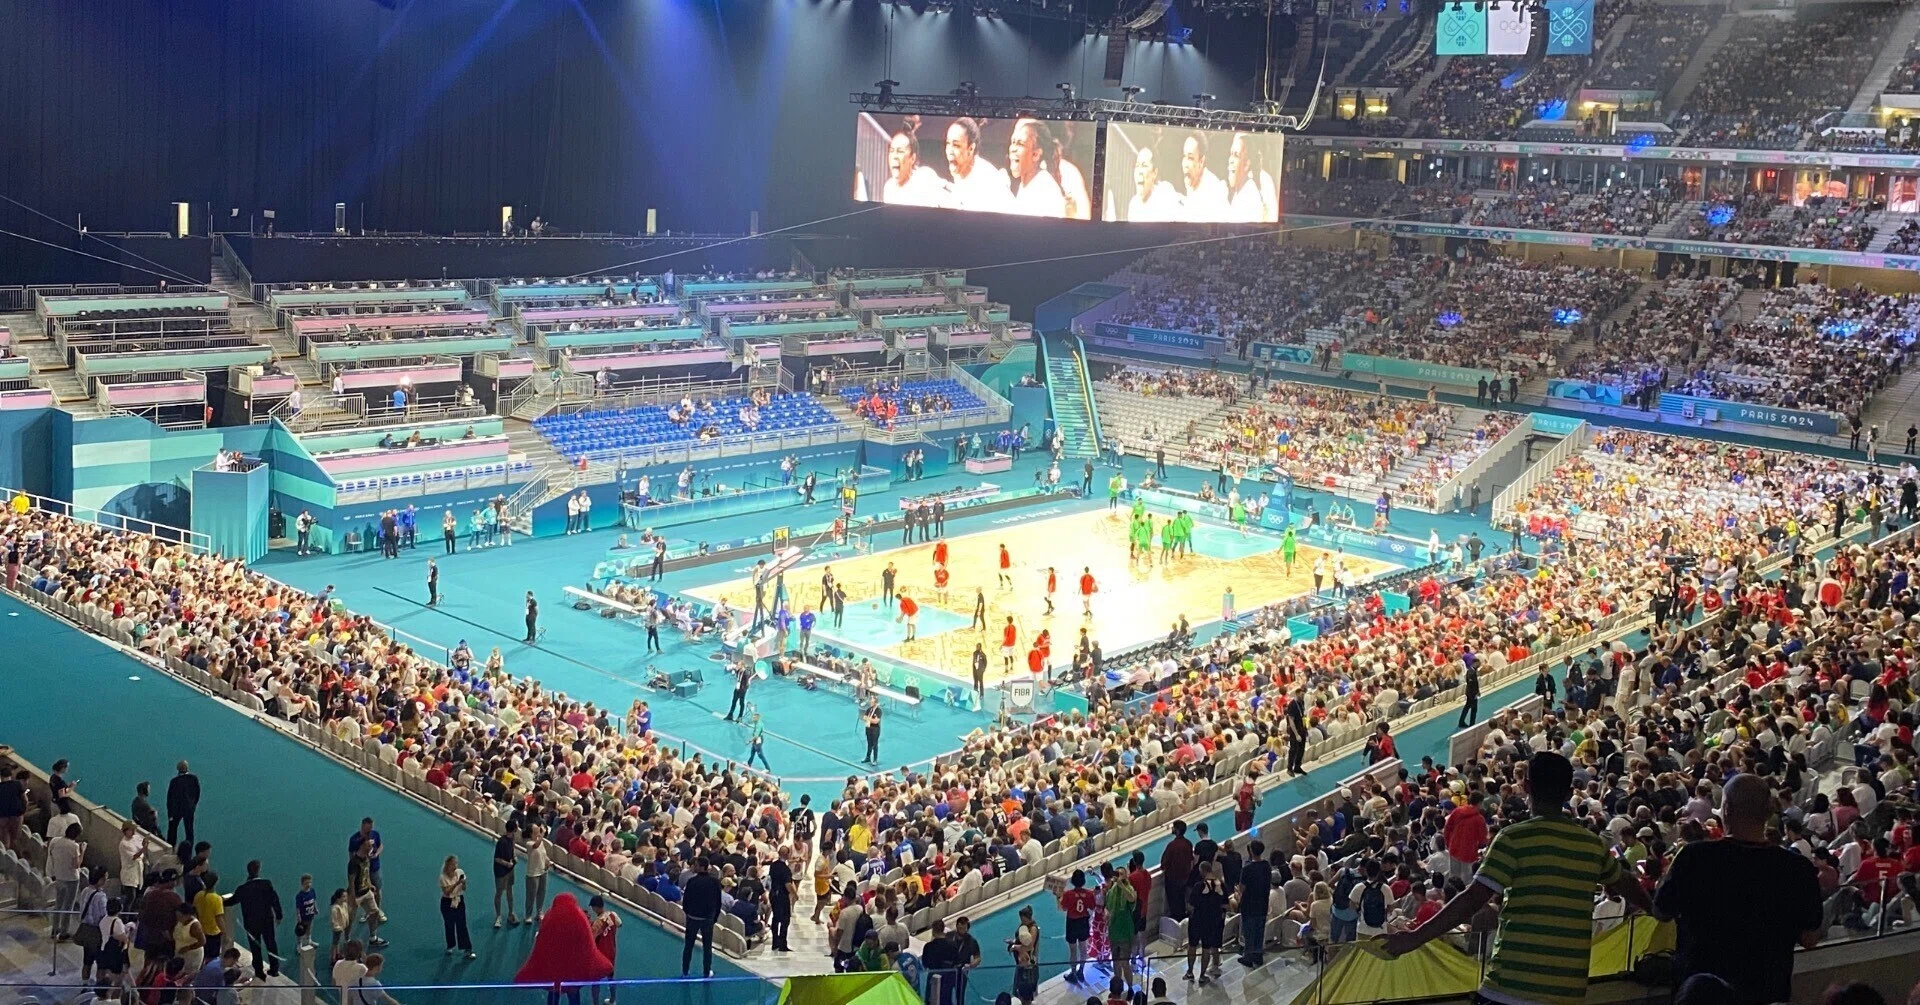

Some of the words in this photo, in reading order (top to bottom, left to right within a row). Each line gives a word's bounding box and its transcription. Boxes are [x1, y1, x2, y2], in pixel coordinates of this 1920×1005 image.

[1153, 333, 1176, 343] PARIS
[1178, 336, 1199, 346] 2024
[1418, 367, 1447, 378] PARIS
[1450, 372, 1477, 382] 2024
[1741, 409, 1777, 421] PARIS
[1781, 414, 1814, 426] 2024
[1014, 688, 1030, 697] FIBA
[1076, 899, 1084, 912] 6
